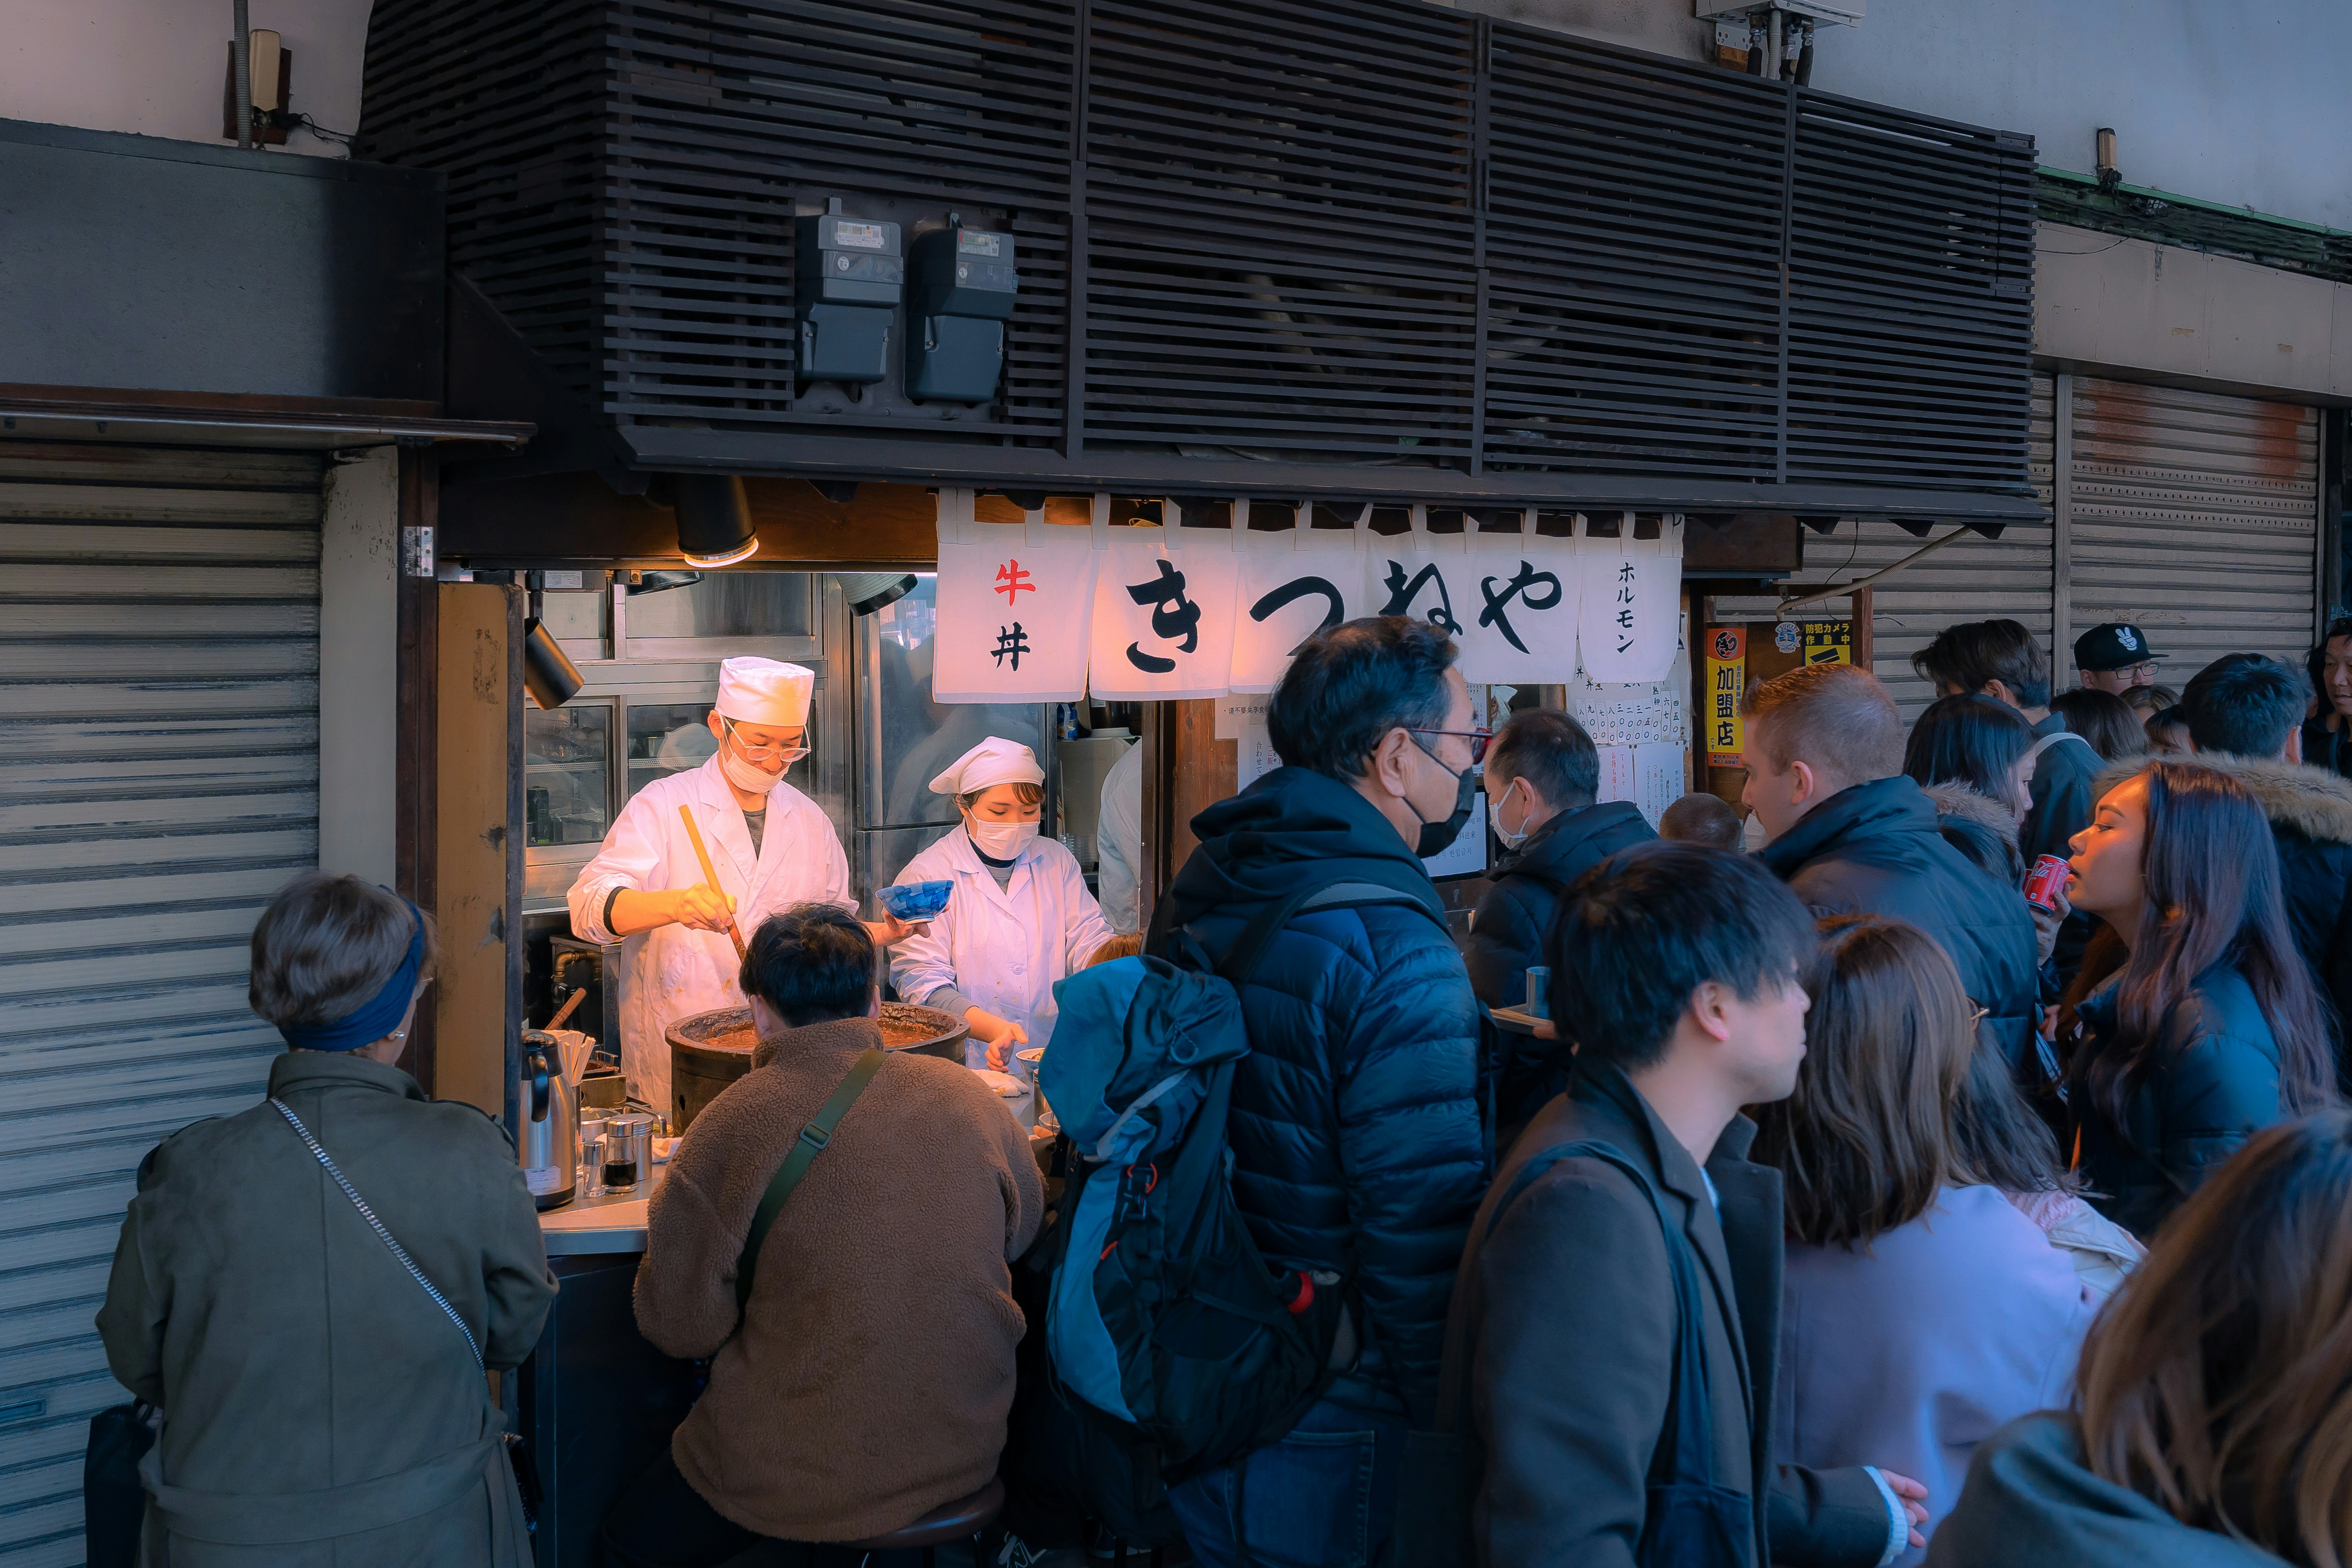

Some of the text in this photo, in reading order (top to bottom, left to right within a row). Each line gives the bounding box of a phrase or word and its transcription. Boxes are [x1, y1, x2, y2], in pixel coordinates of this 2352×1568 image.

[990, 559, 1036, 671] 牛丼
[1125, 559, 1562, 673] きつねや
[1615, 561, 1635, 653] ホルモン
[1806, 623, 1849, 633] 防犯カメラ
[1806, 634, 1850, 645] 作動中
[1717, 665, 1734, 746] 加盟店
[1710, 737, 1715, 750] です
[1449, 847, 1472, 858] 반입금지
